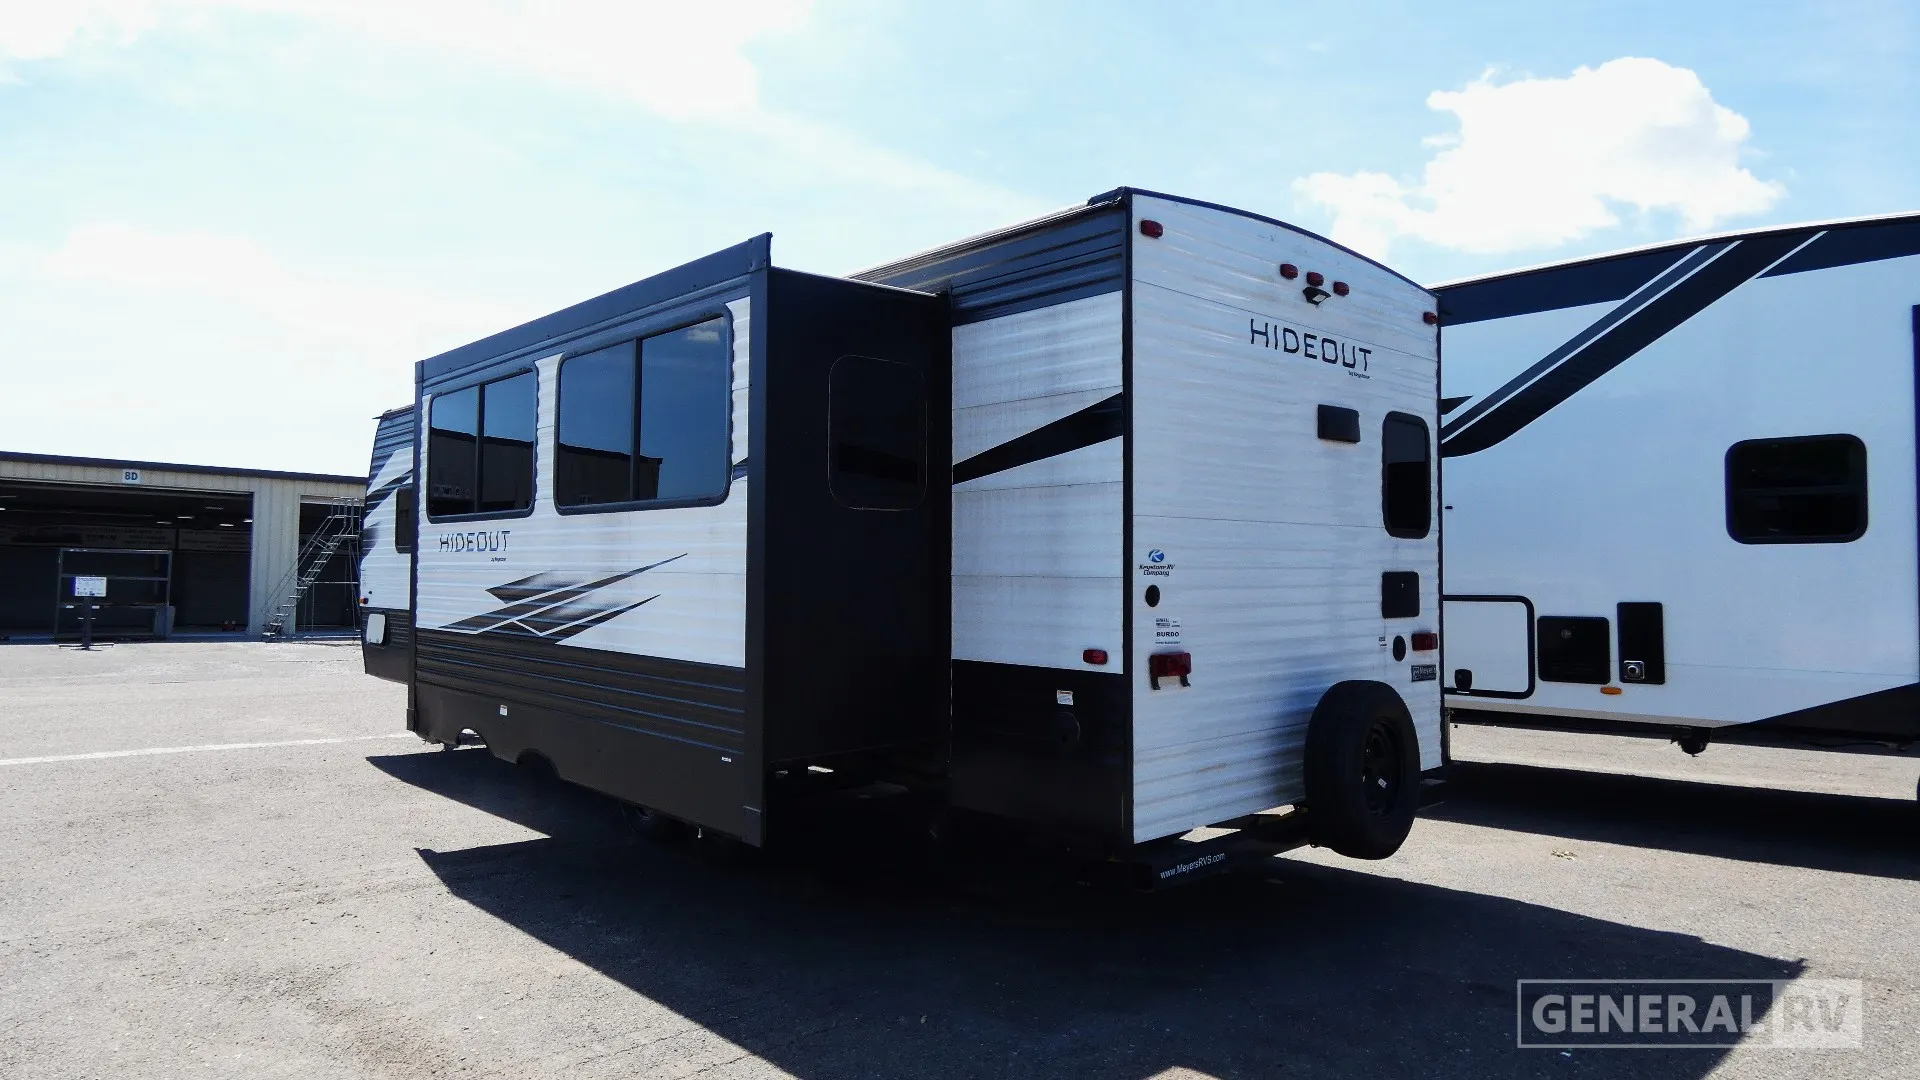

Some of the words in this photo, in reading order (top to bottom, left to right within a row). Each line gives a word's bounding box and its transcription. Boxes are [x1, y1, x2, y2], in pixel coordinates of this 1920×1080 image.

[1250, 318, 1372, 371] HIDEOUT
[124, 471, 138, 481] 8D
[439, 530, 510, 552] HIDEOUT
